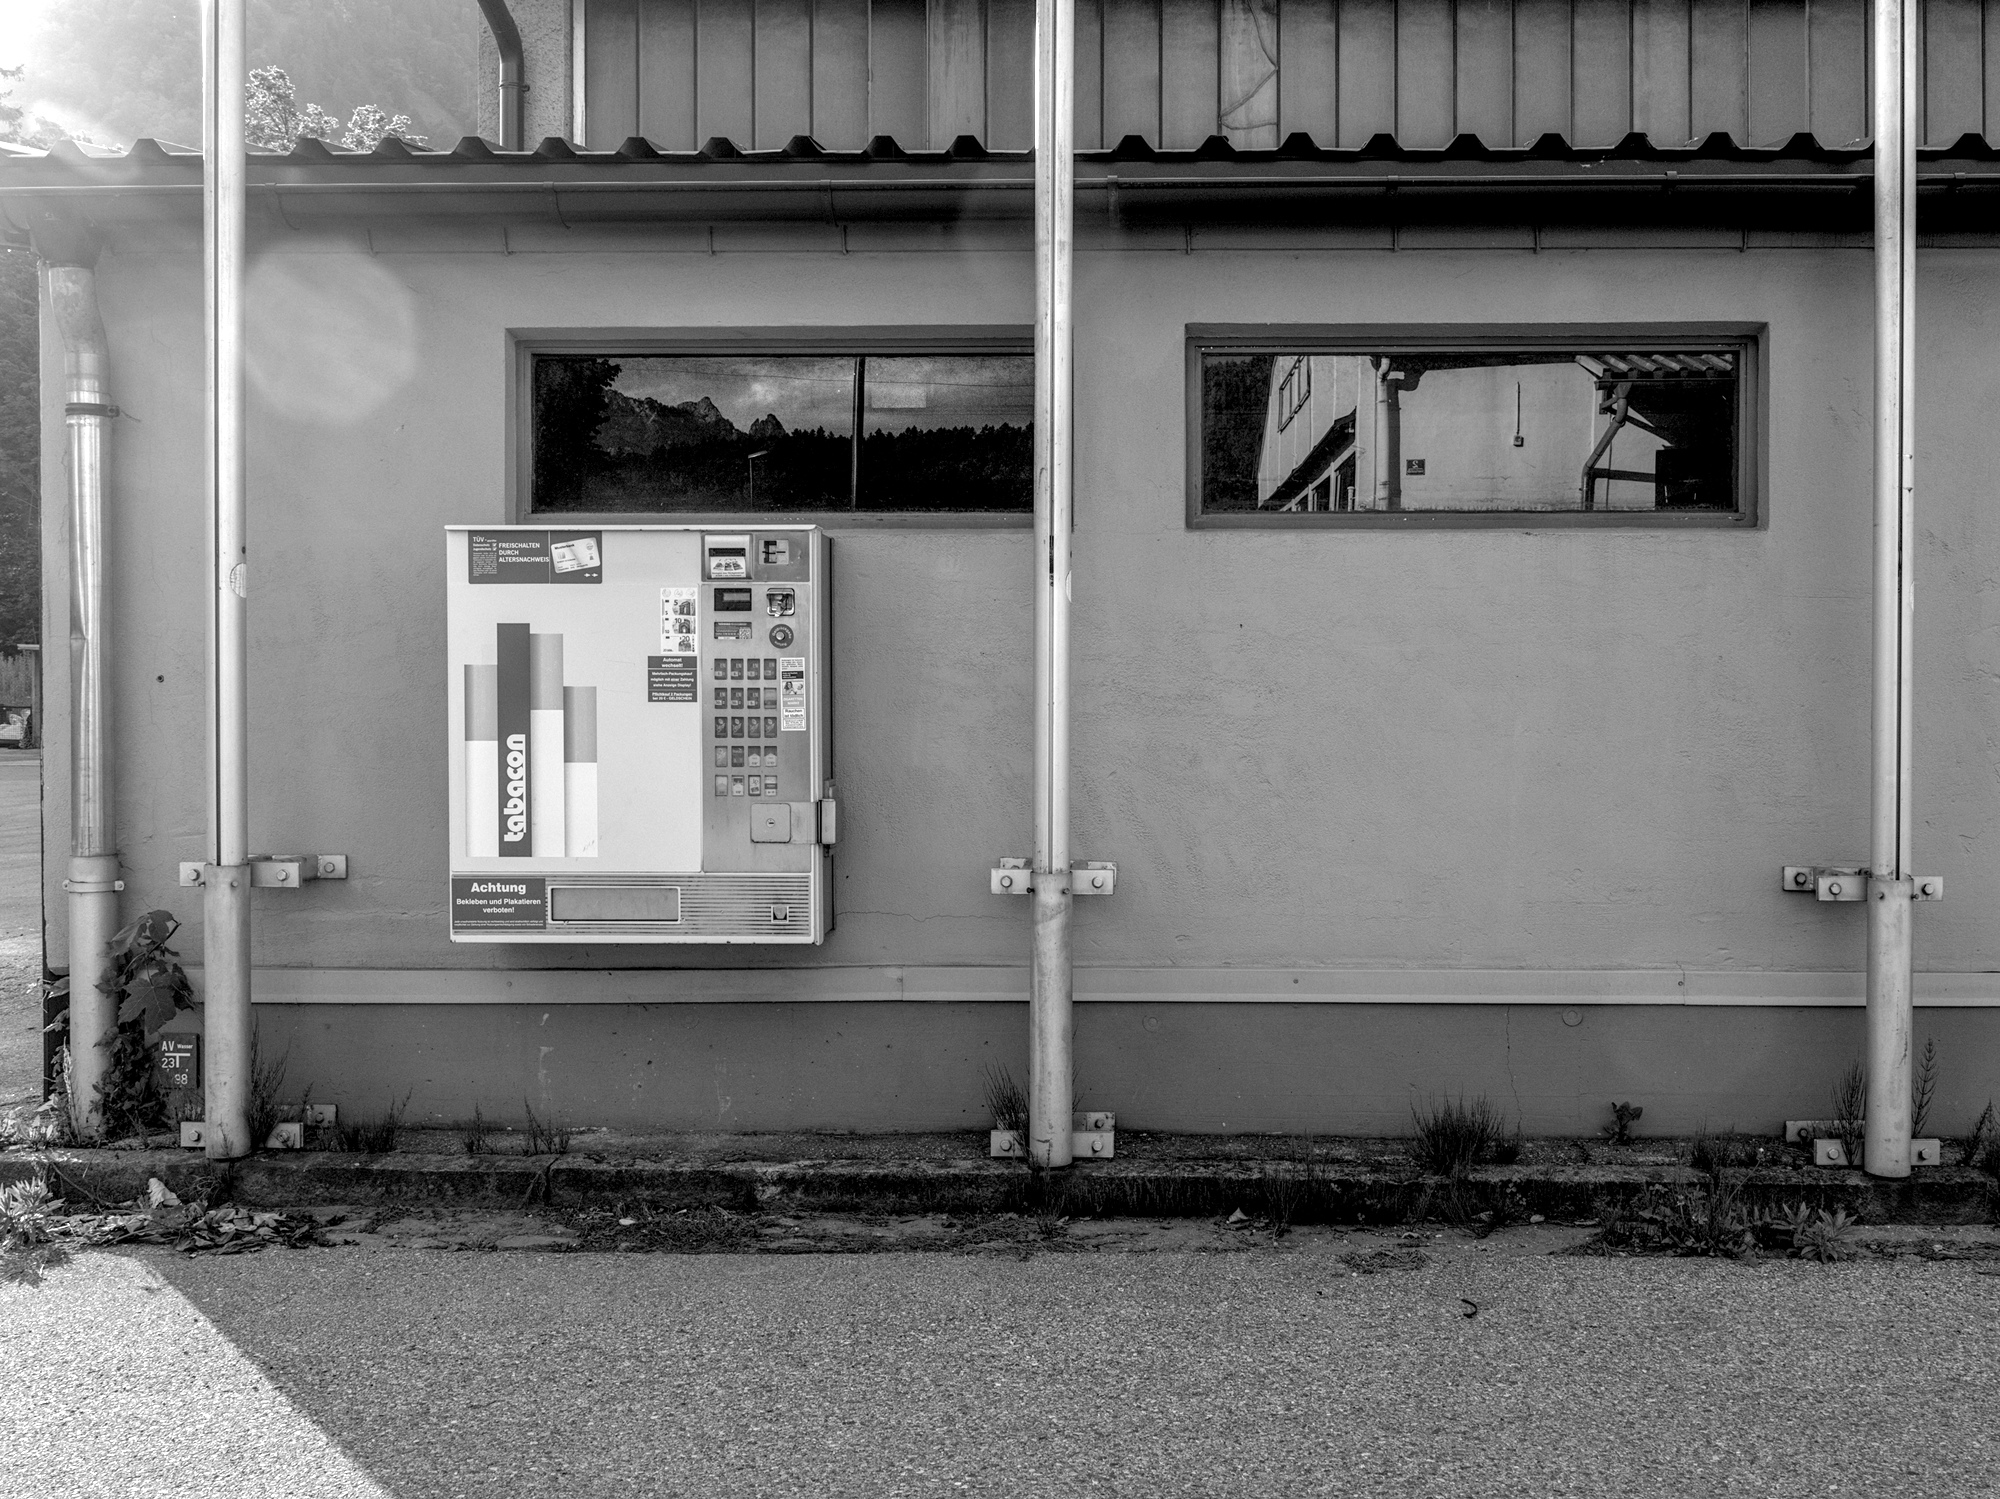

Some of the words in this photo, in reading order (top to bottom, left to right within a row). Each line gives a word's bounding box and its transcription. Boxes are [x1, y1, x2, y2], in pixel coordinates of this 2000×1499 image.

[503, 734, 526, 842] tabacon
[471, 882, 526, 895] Achtung
[482, 906, 515, 914] verboten!
[161, 1041, 175, 1051] AV
[161, 1057, 175, 1068] 23
[174, 1073, 188, 1085] 98
